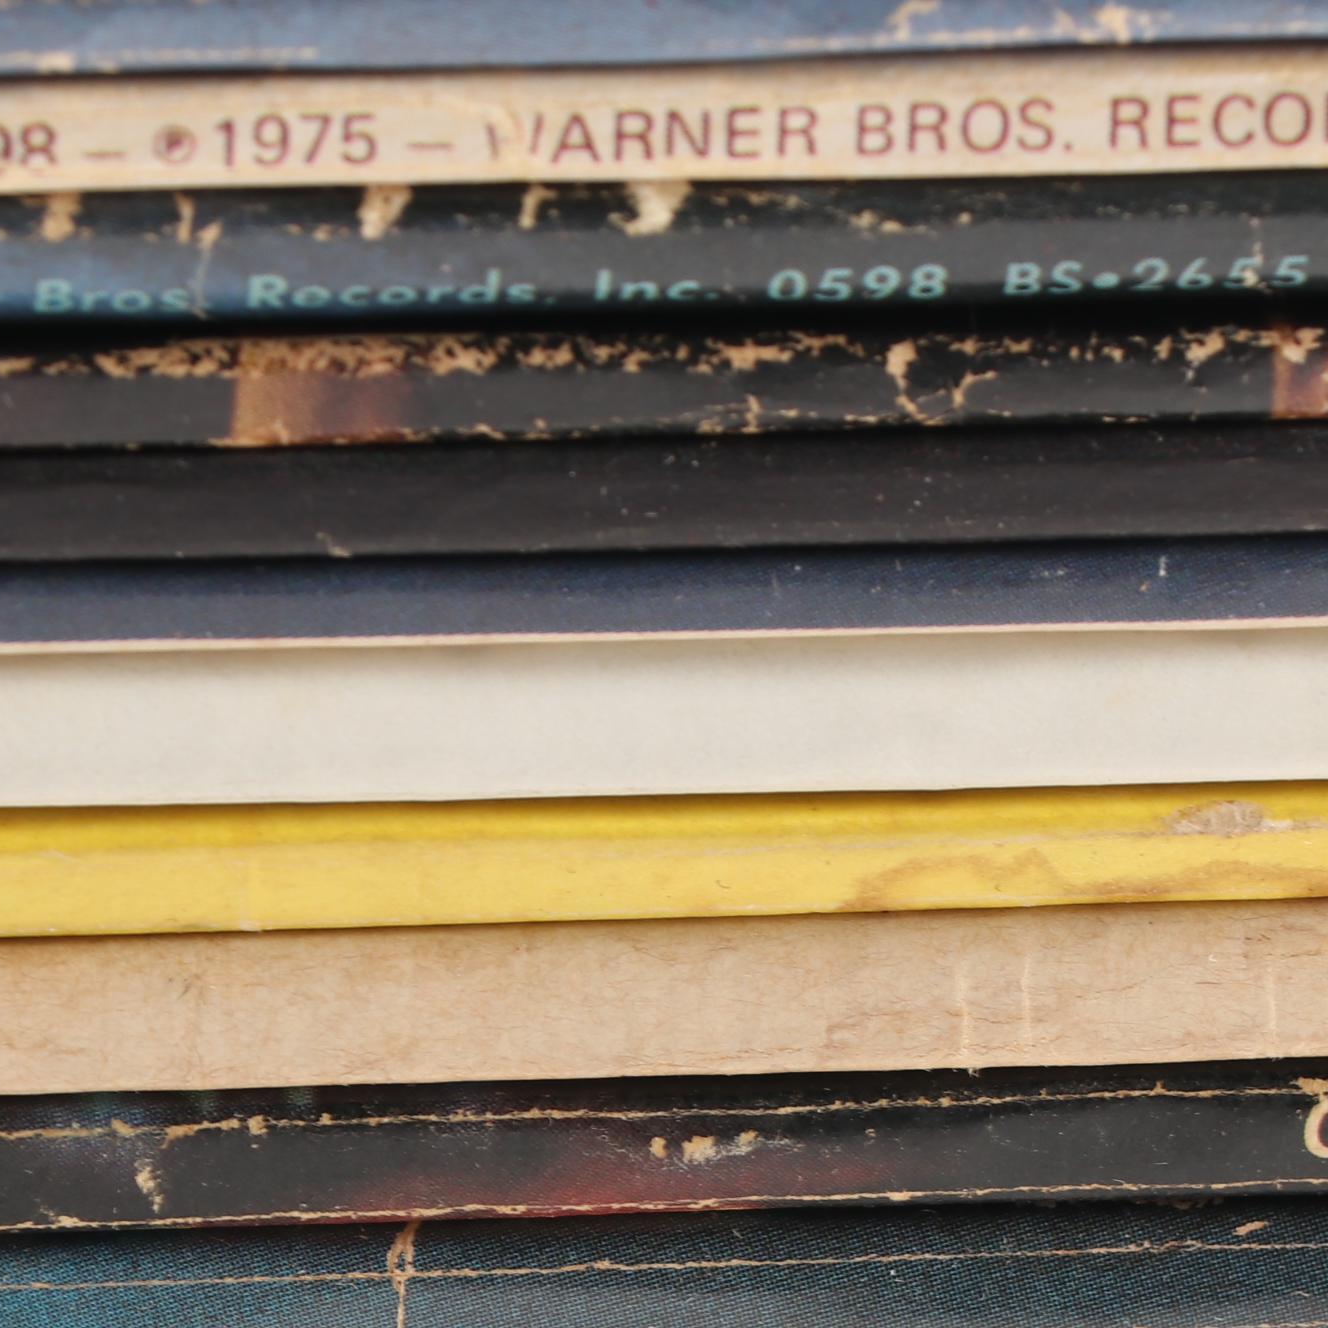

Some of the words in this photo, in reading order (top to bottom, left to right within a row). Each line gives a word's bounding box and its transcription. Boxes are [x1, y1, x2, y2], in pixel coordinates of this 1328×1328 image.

[854, 96, 1074, 159] BROS.
[593, 268, 720, 303] Inc.
[767, 263, 950, 303] 0598
